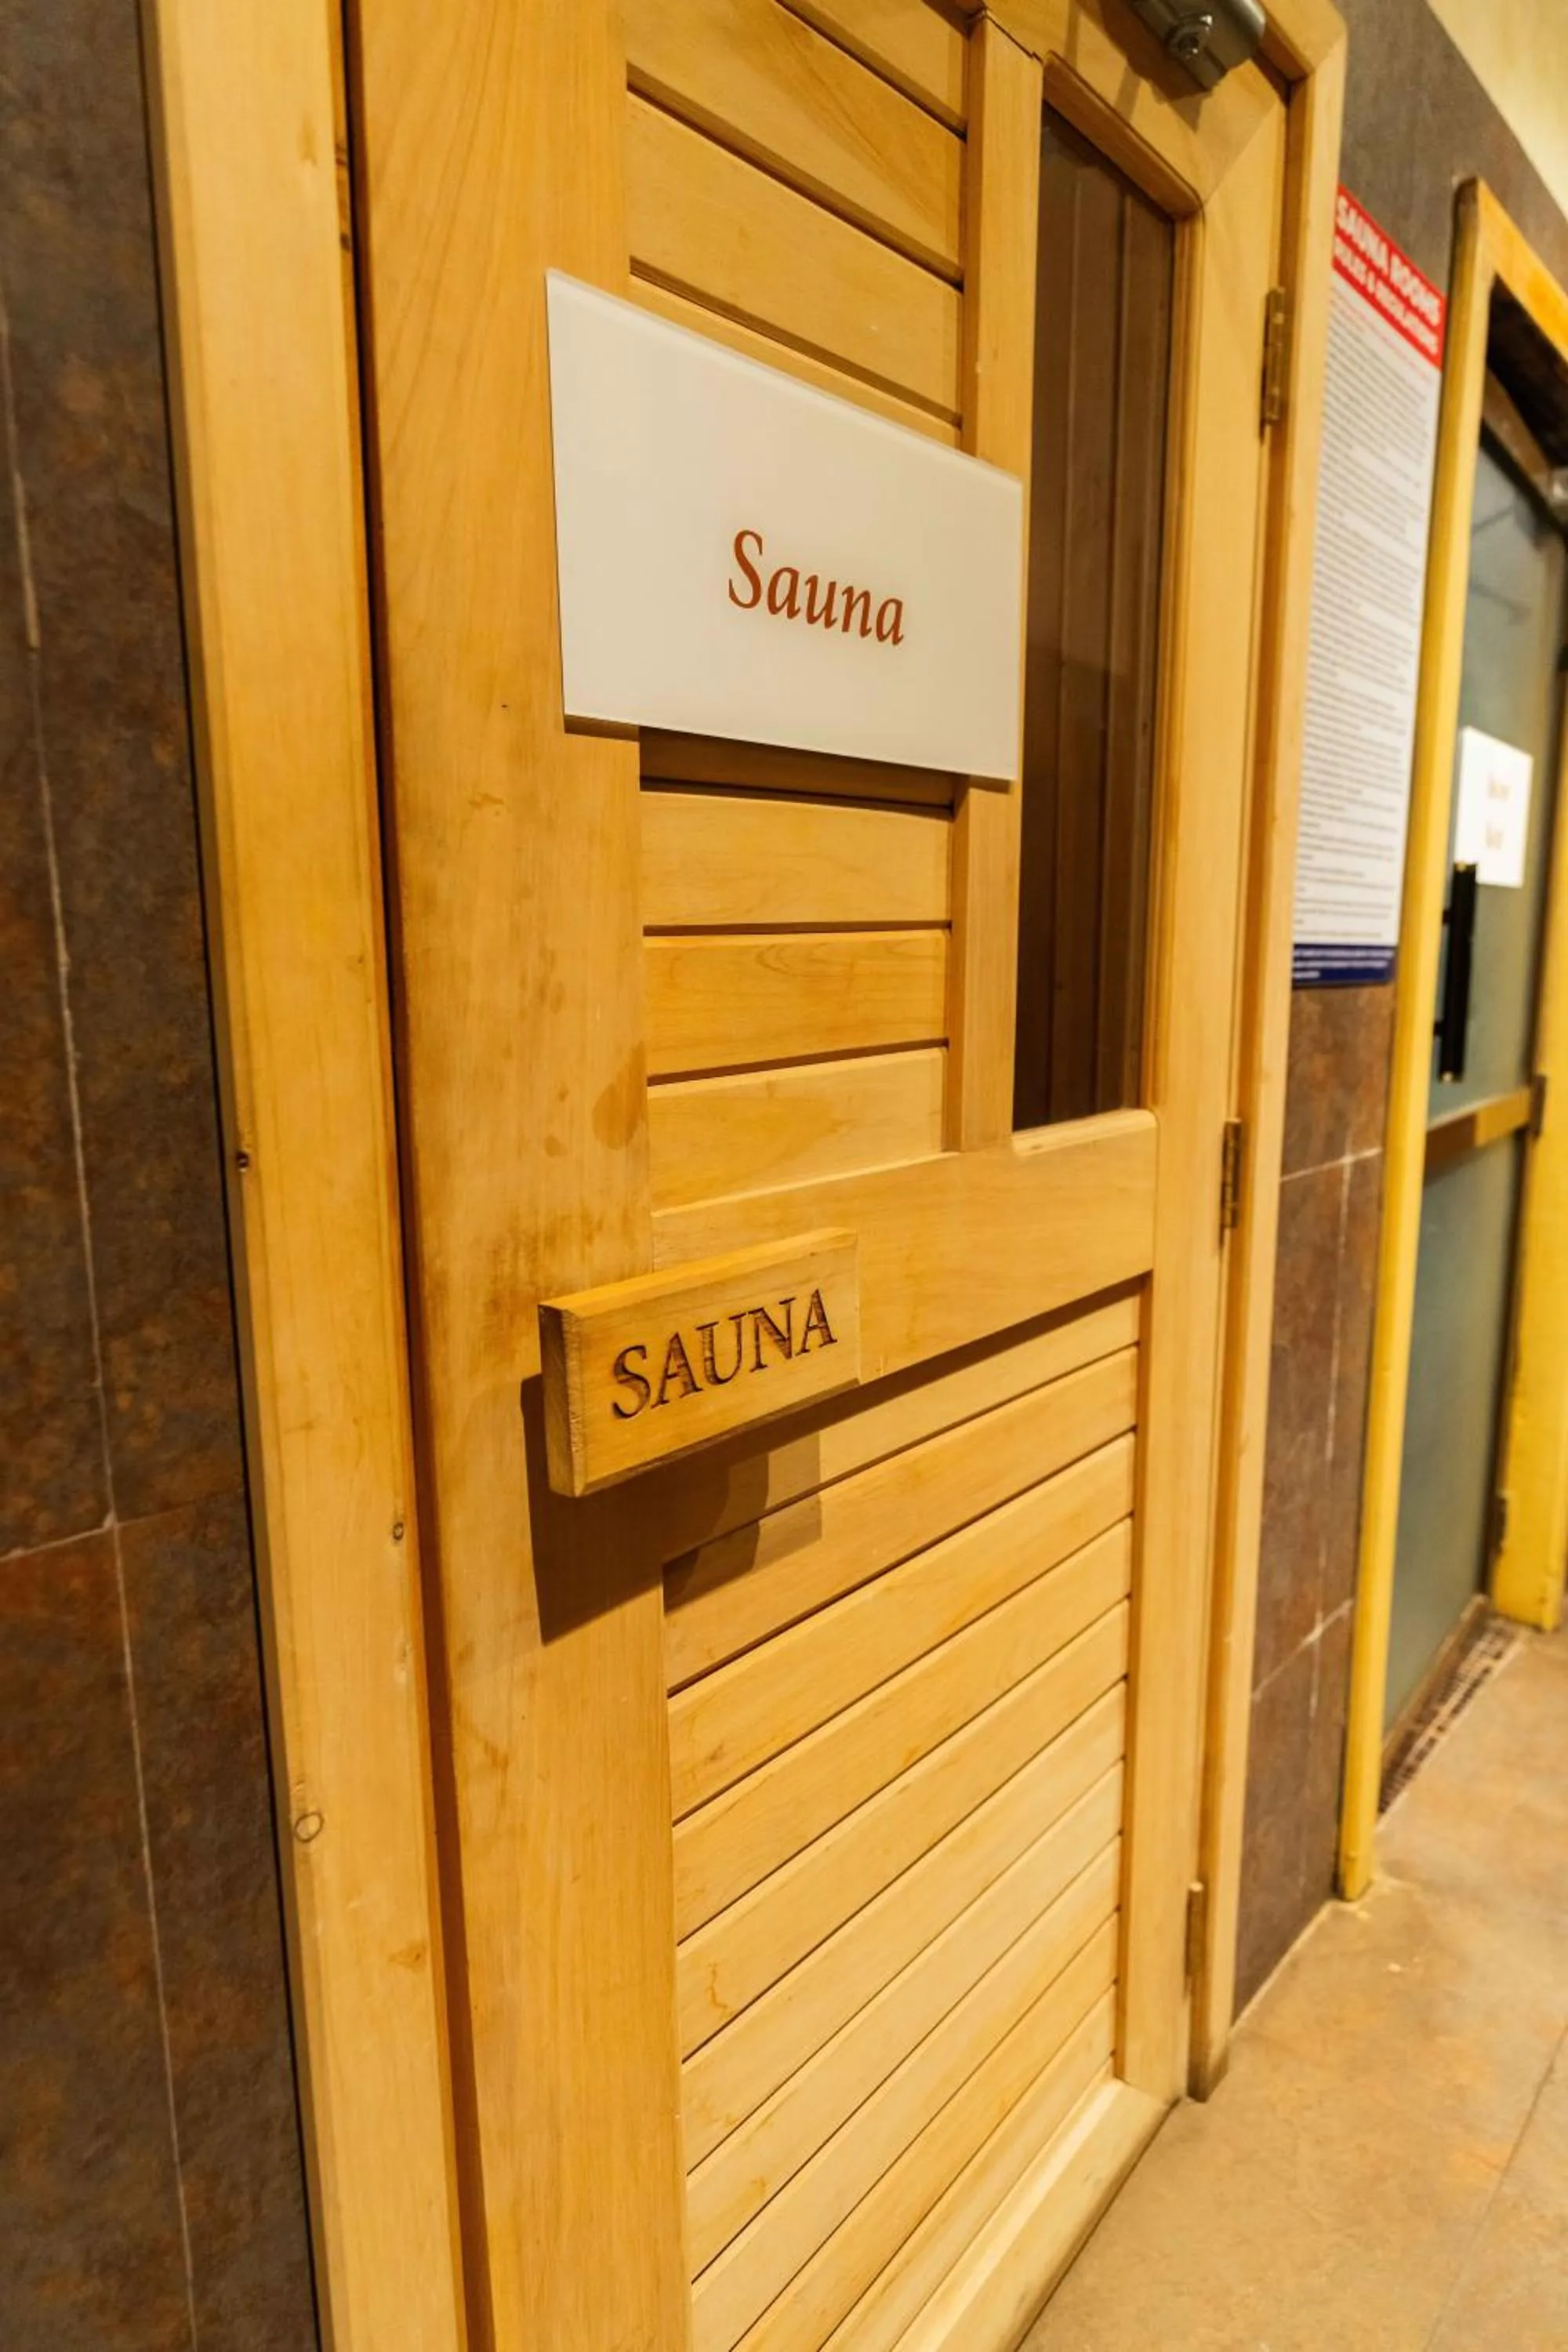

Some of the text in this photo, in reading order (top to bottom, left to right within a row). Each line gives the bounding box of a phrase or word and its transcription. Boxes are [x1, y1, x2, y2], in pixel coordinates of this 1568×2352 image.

[1336, 194, 1388, 277] SAUNA
[728, 529, 904, 645] Sauna
[612, 1288, 837, 1419] SAUNA
